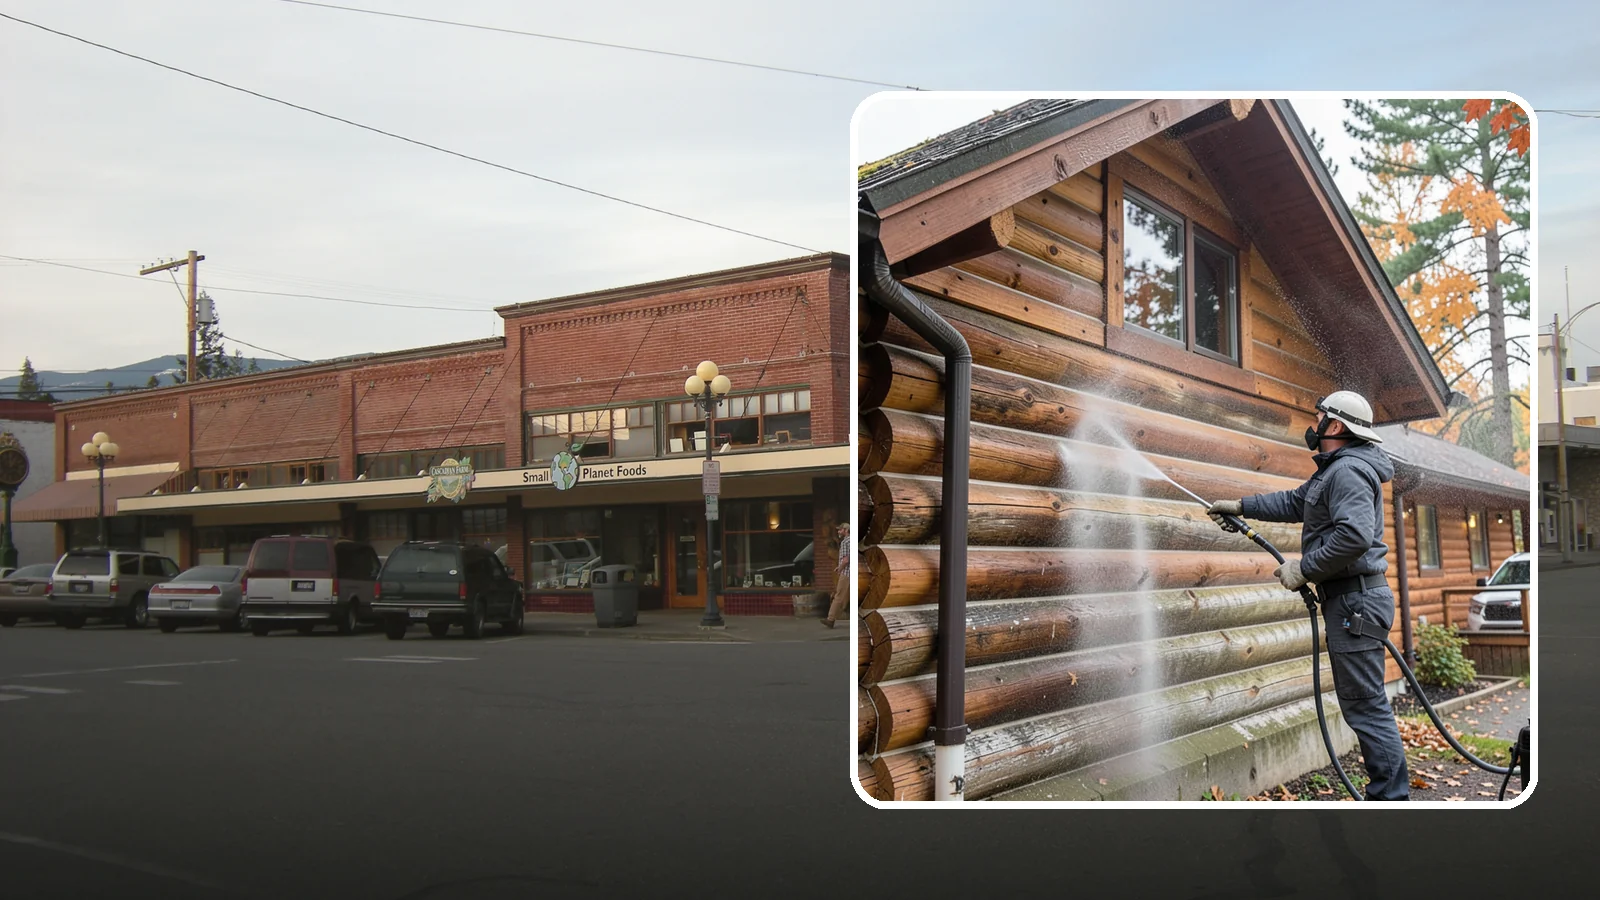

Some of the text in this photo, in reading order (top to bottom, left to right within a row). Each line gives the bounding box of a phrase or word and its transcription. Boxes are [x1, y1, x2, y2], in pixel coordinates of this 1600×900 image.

[523, 465, 647, 482] Small Planet Foods
